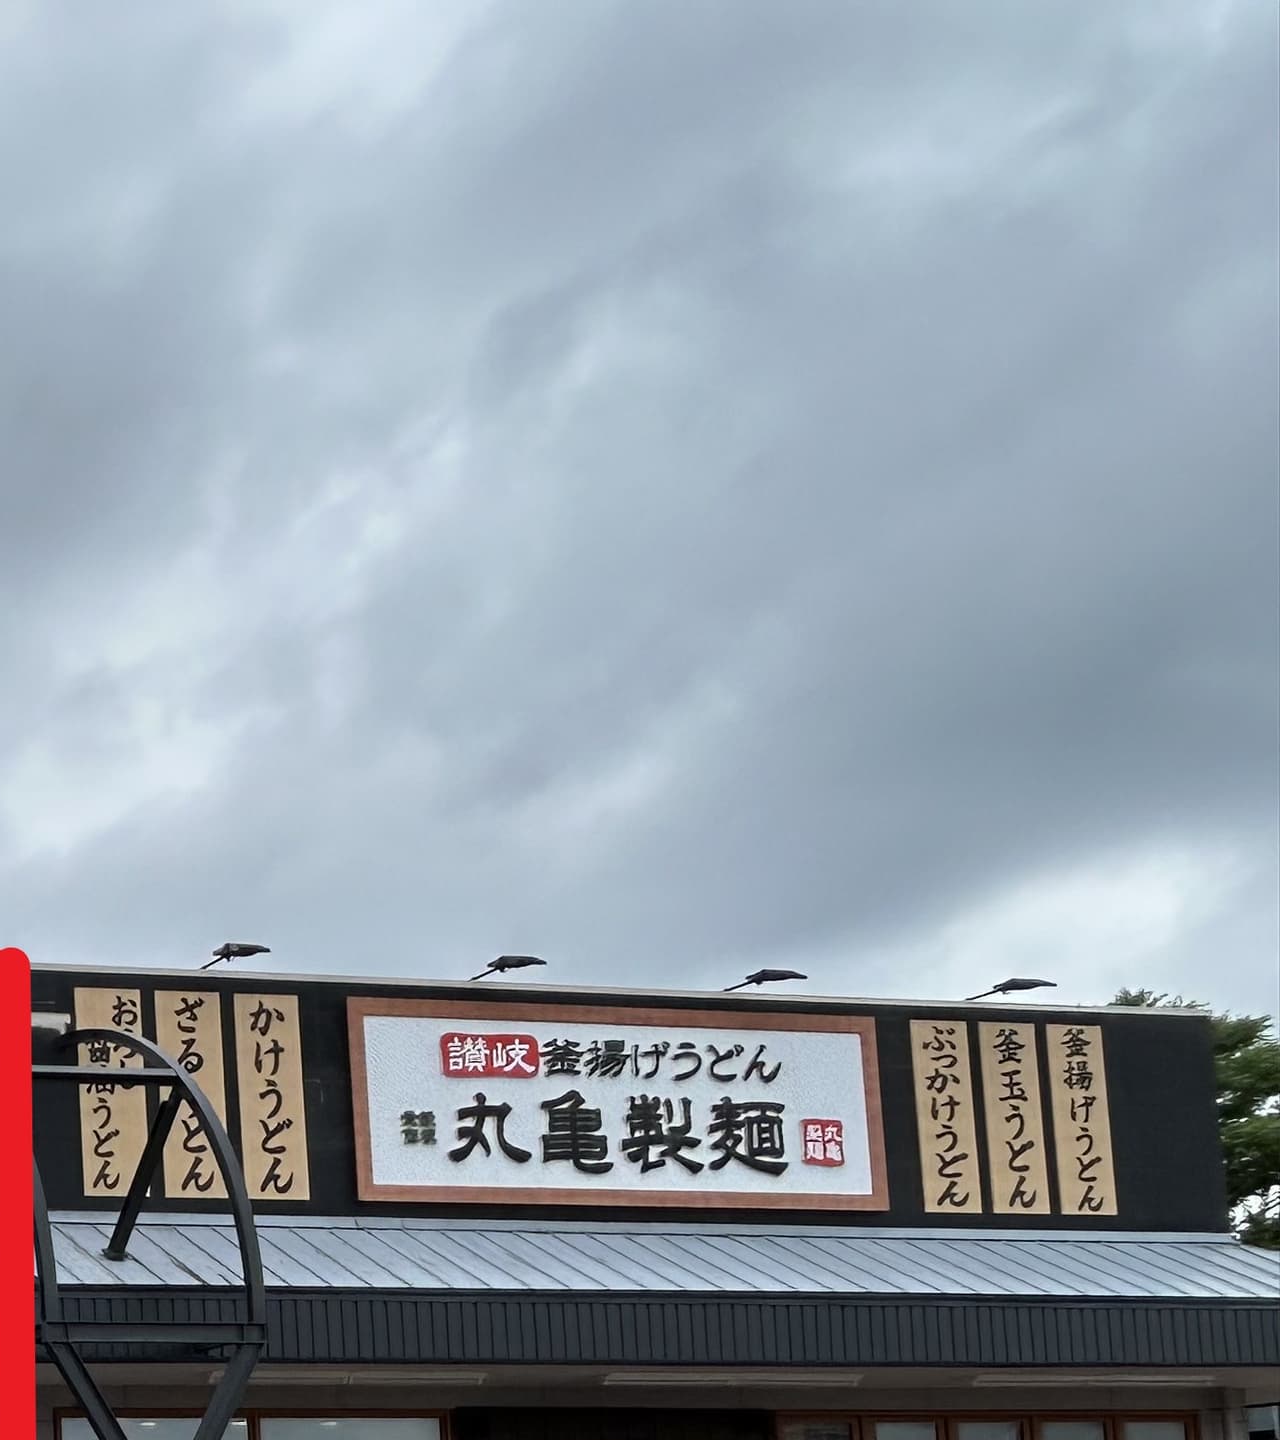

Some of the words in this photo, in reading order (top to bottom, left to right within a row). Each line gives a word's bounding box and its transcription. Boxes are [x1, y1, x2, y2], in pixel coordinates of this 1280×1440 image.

[248, 1000, 295, 1195] かけうどん
[447, 1089, 790, 1178] 丸亀製麺
[921, 1025, 970, 1208] ぶっかけうどん
[992, 1028, 1037, 1209] 釜玉うどん
[1059, 1027, 1105, 1213] 釜揚げうどん
